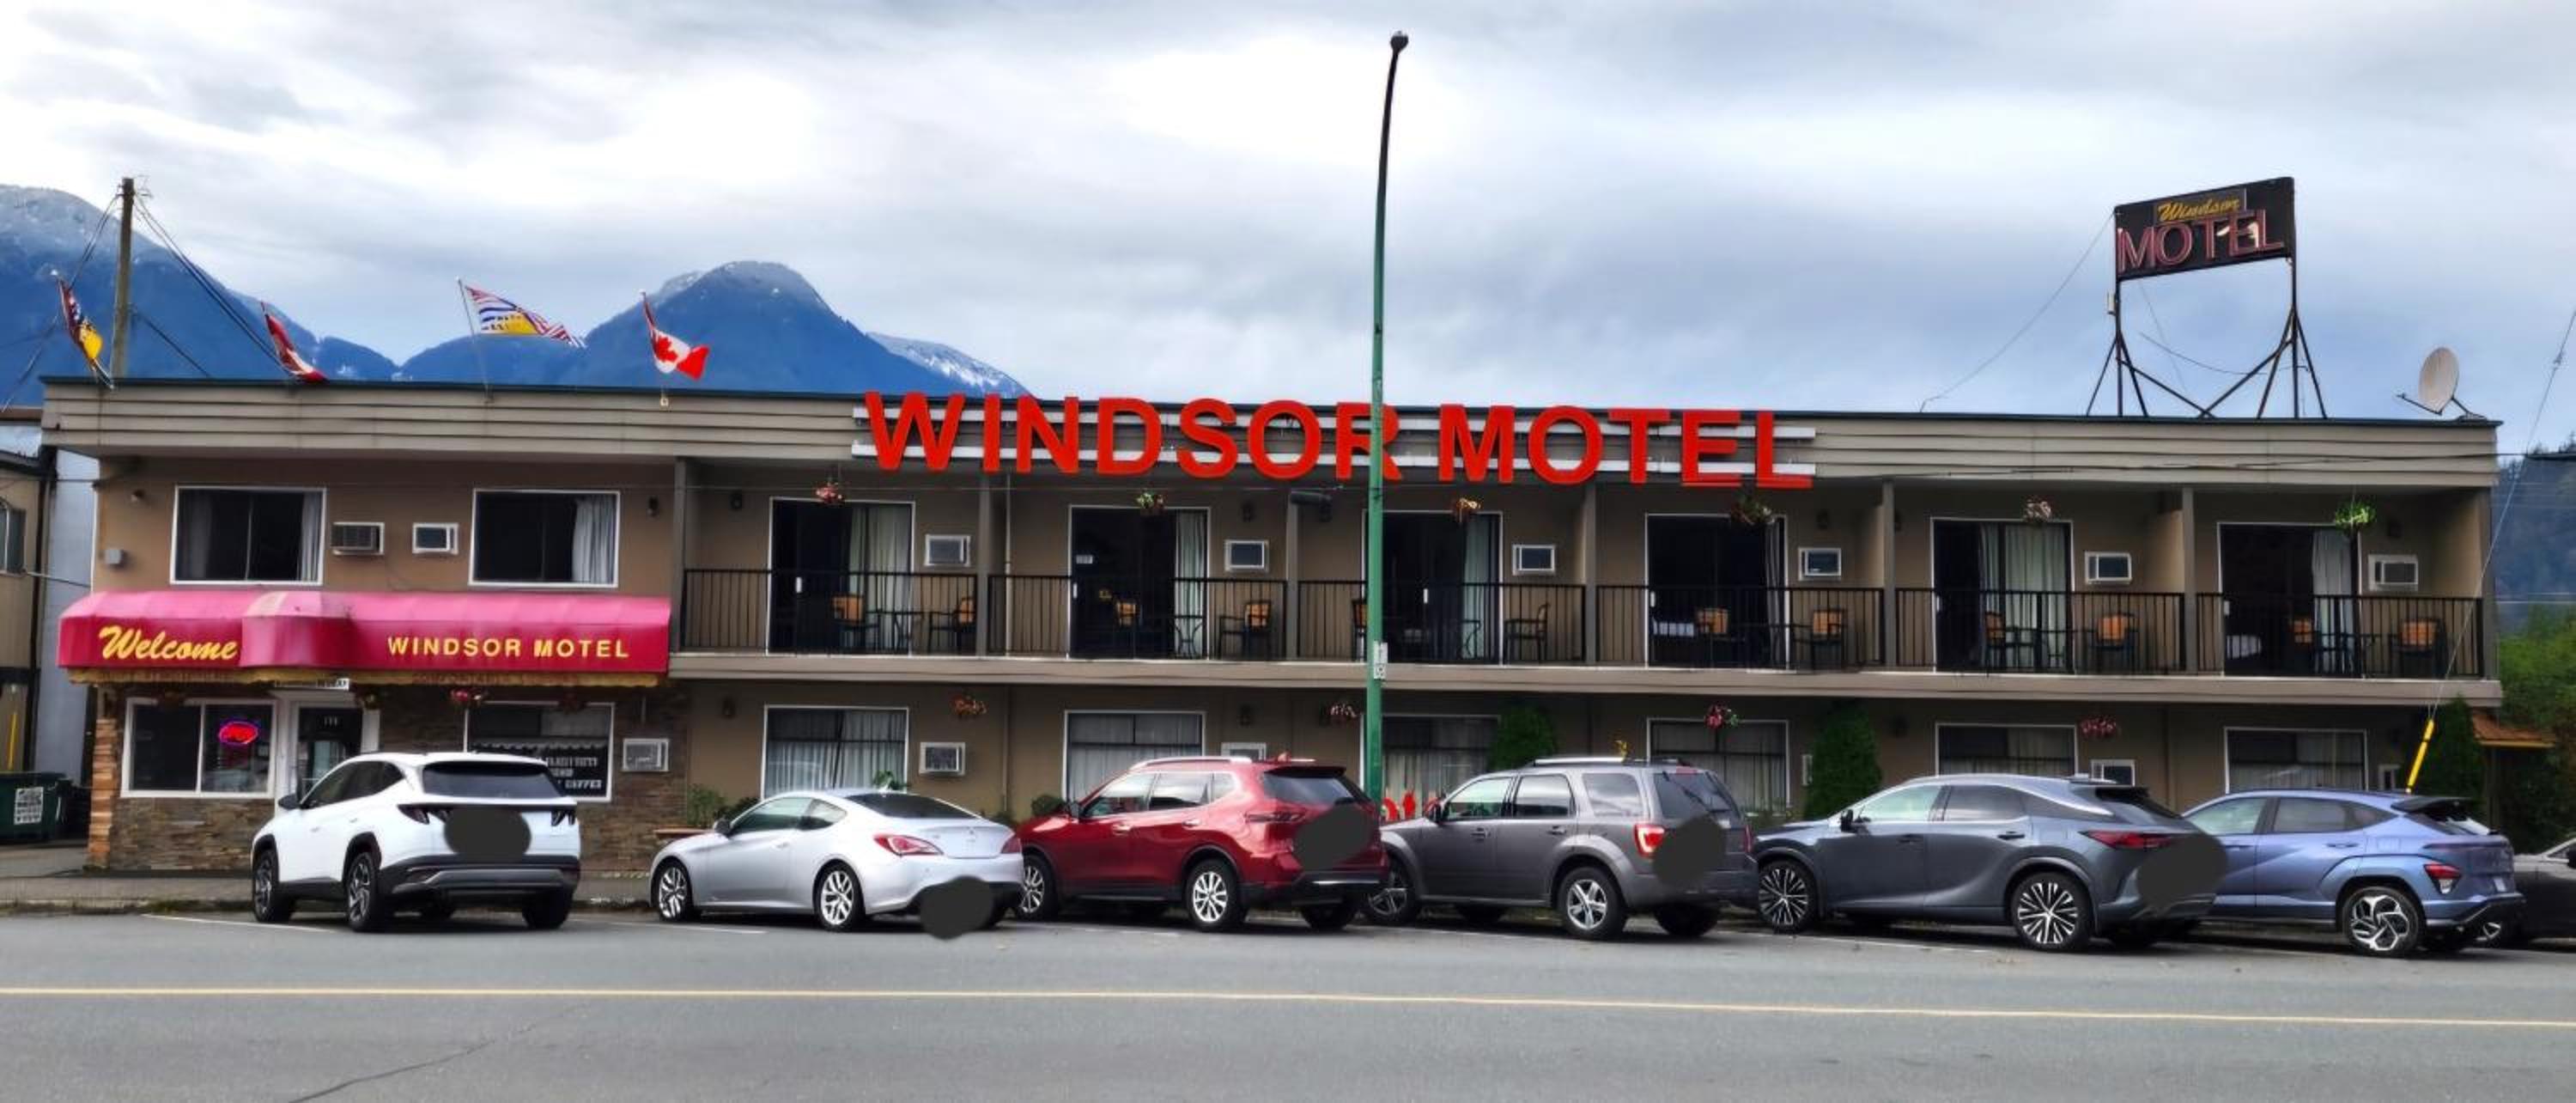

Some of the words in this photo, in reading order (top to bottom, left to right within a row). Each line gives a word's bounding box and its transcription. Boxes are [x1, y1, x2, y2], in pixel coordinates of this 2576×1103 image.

[2157, 196, 2241, 222] Windsor
[2117, 210, 2285, 272] MOTEL
[865, 391, 1402, 480] WINDSOR
[1438, 403, 1814, 488] MOTEL
[99, 625, 239, 660] Welcome
[387, 637, 521, 658] WINDSOR
[533, 638, 630, 658] MOTEL
